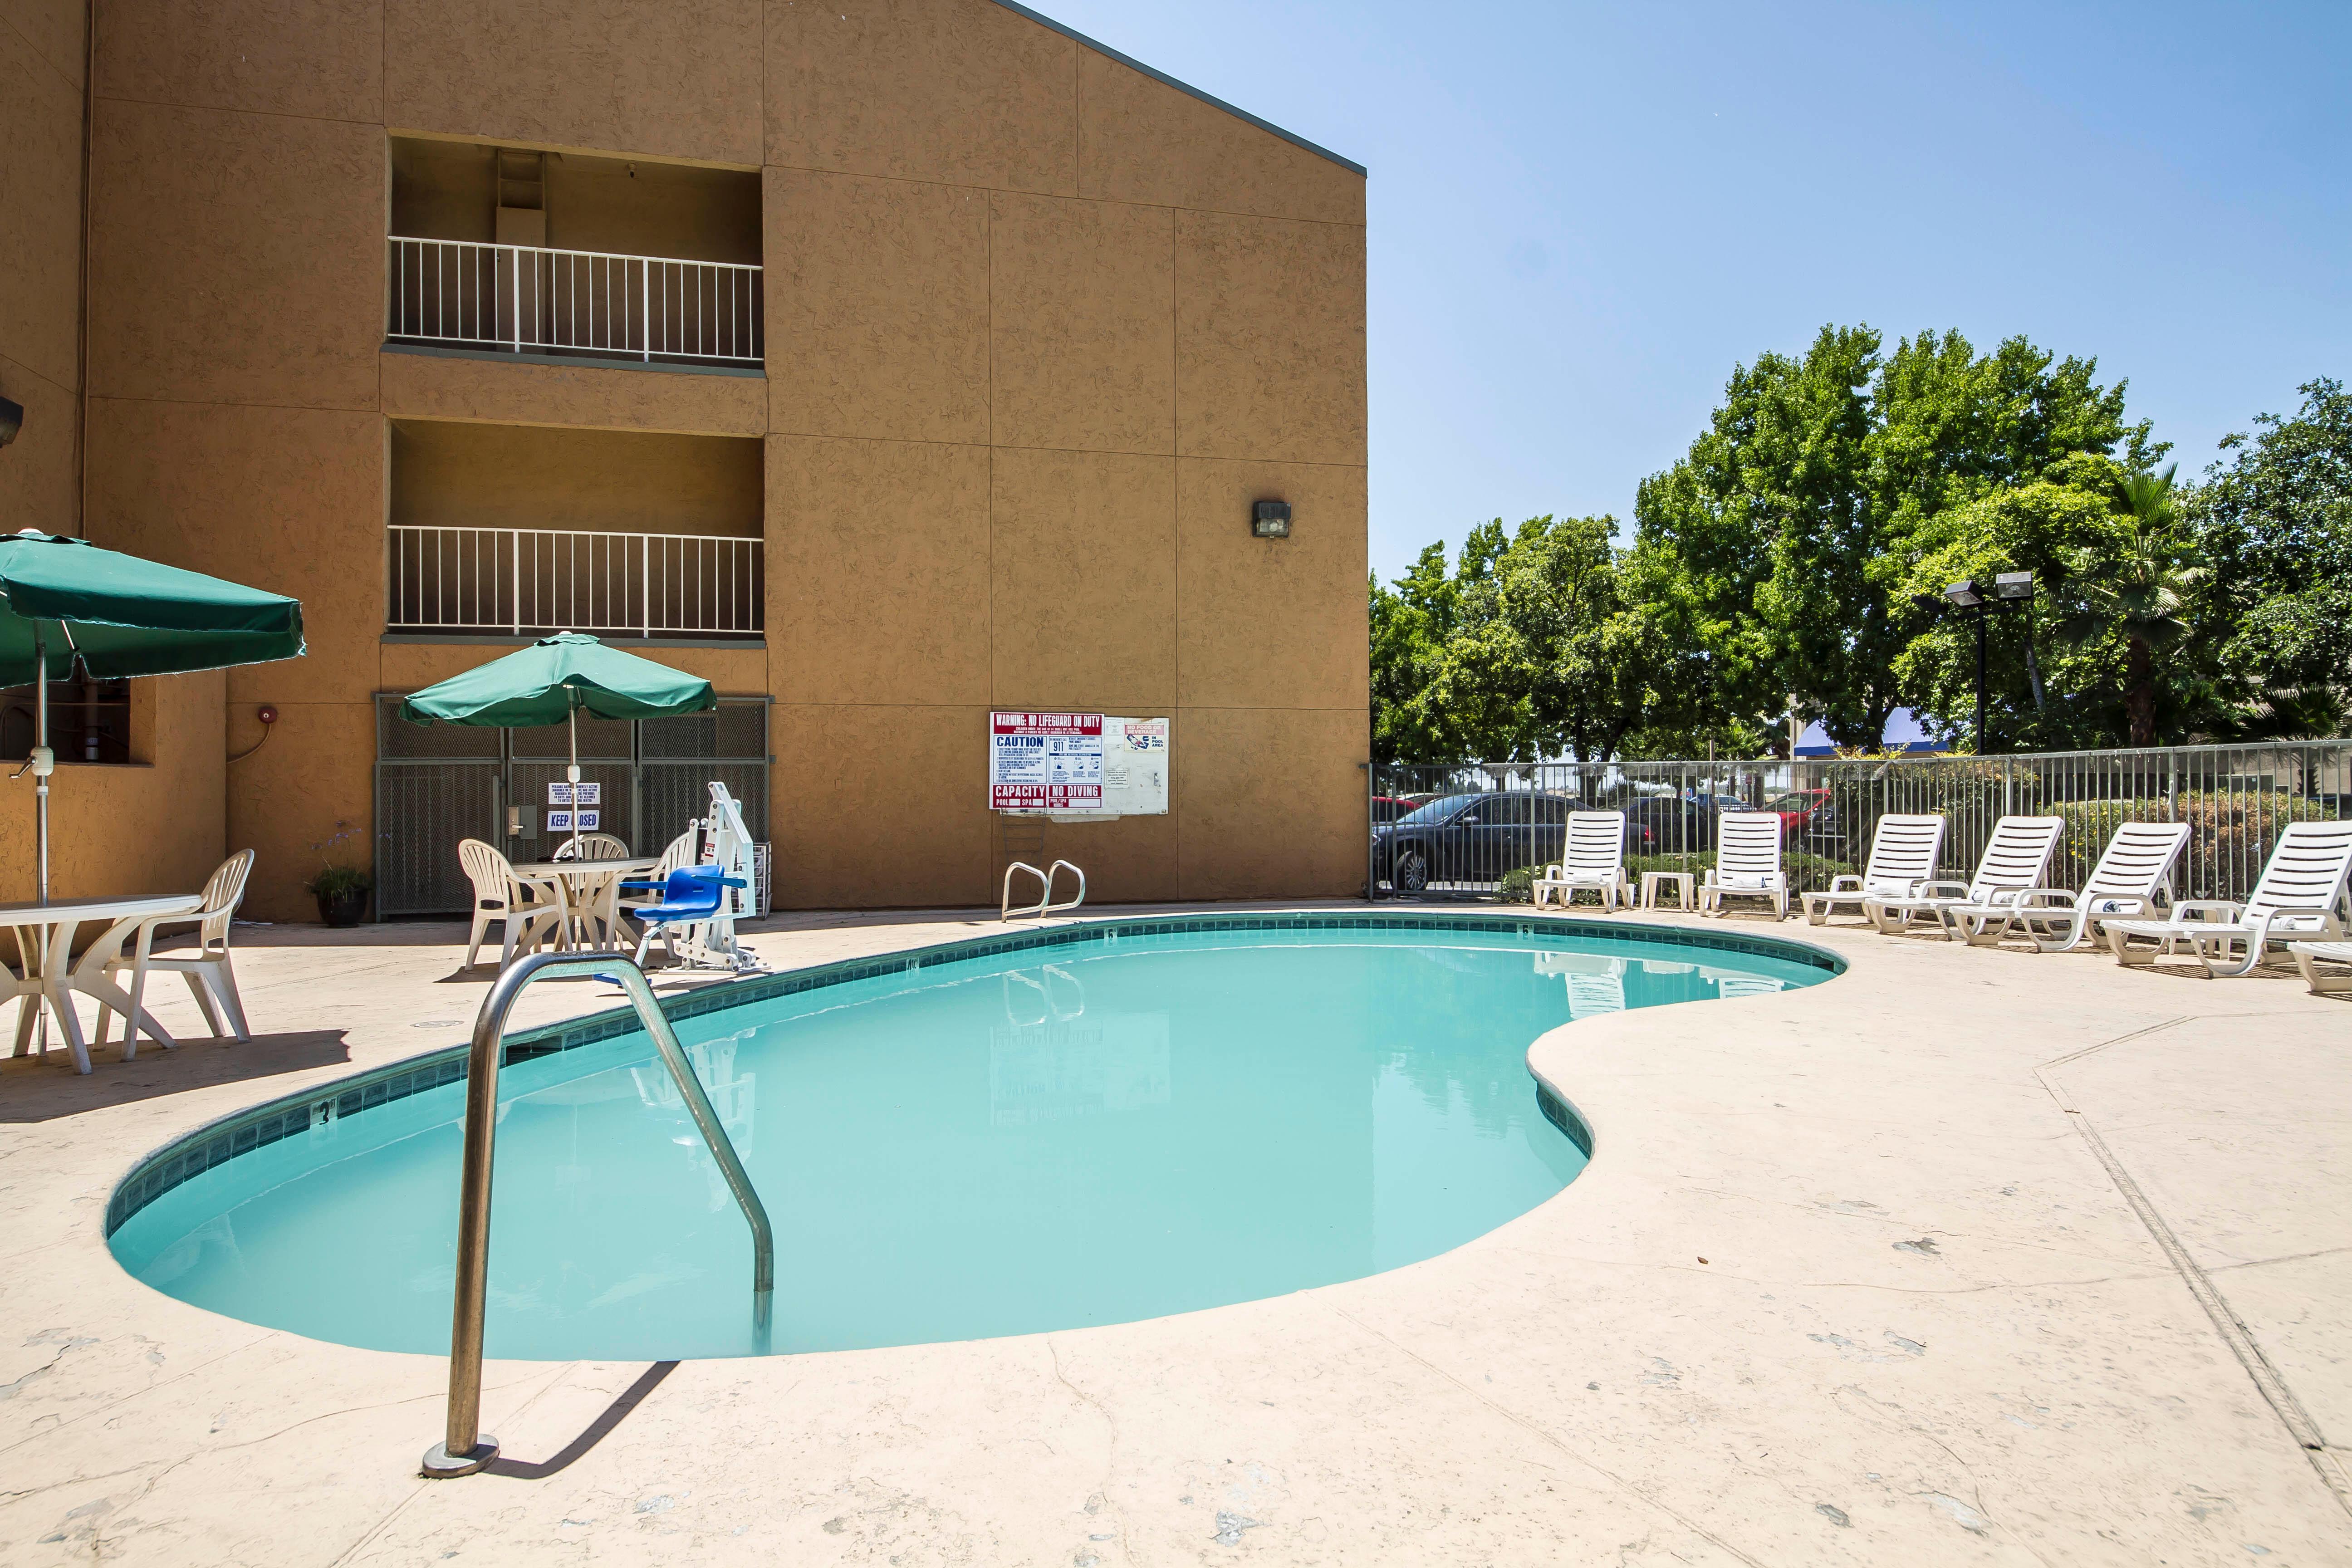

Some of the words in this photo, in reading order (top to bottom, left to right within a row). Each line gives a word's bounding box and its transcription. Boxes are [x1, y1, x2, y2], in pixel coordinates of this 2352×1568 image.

[996, 714, 1026, 726] WARNING:
[1029, 715, 1037, 726] NO
[1039, 715, 1071, 727] LIFEGUARD
[1073, 715, 1082, 727] ON
[1083, 715, 1100, 727] DUTY
[997, 736, 1044, 747] CAUTION
[1054, 741, 1063, 752] 911
[996, 786, 1045, 797] CAPACITY
[1052, 786, 1064, 797] NO
[1068, 786, 1098, 797] DIVING
[551, 815, 569, 827] KEEP
[571, 814, 596, 826] OSED
